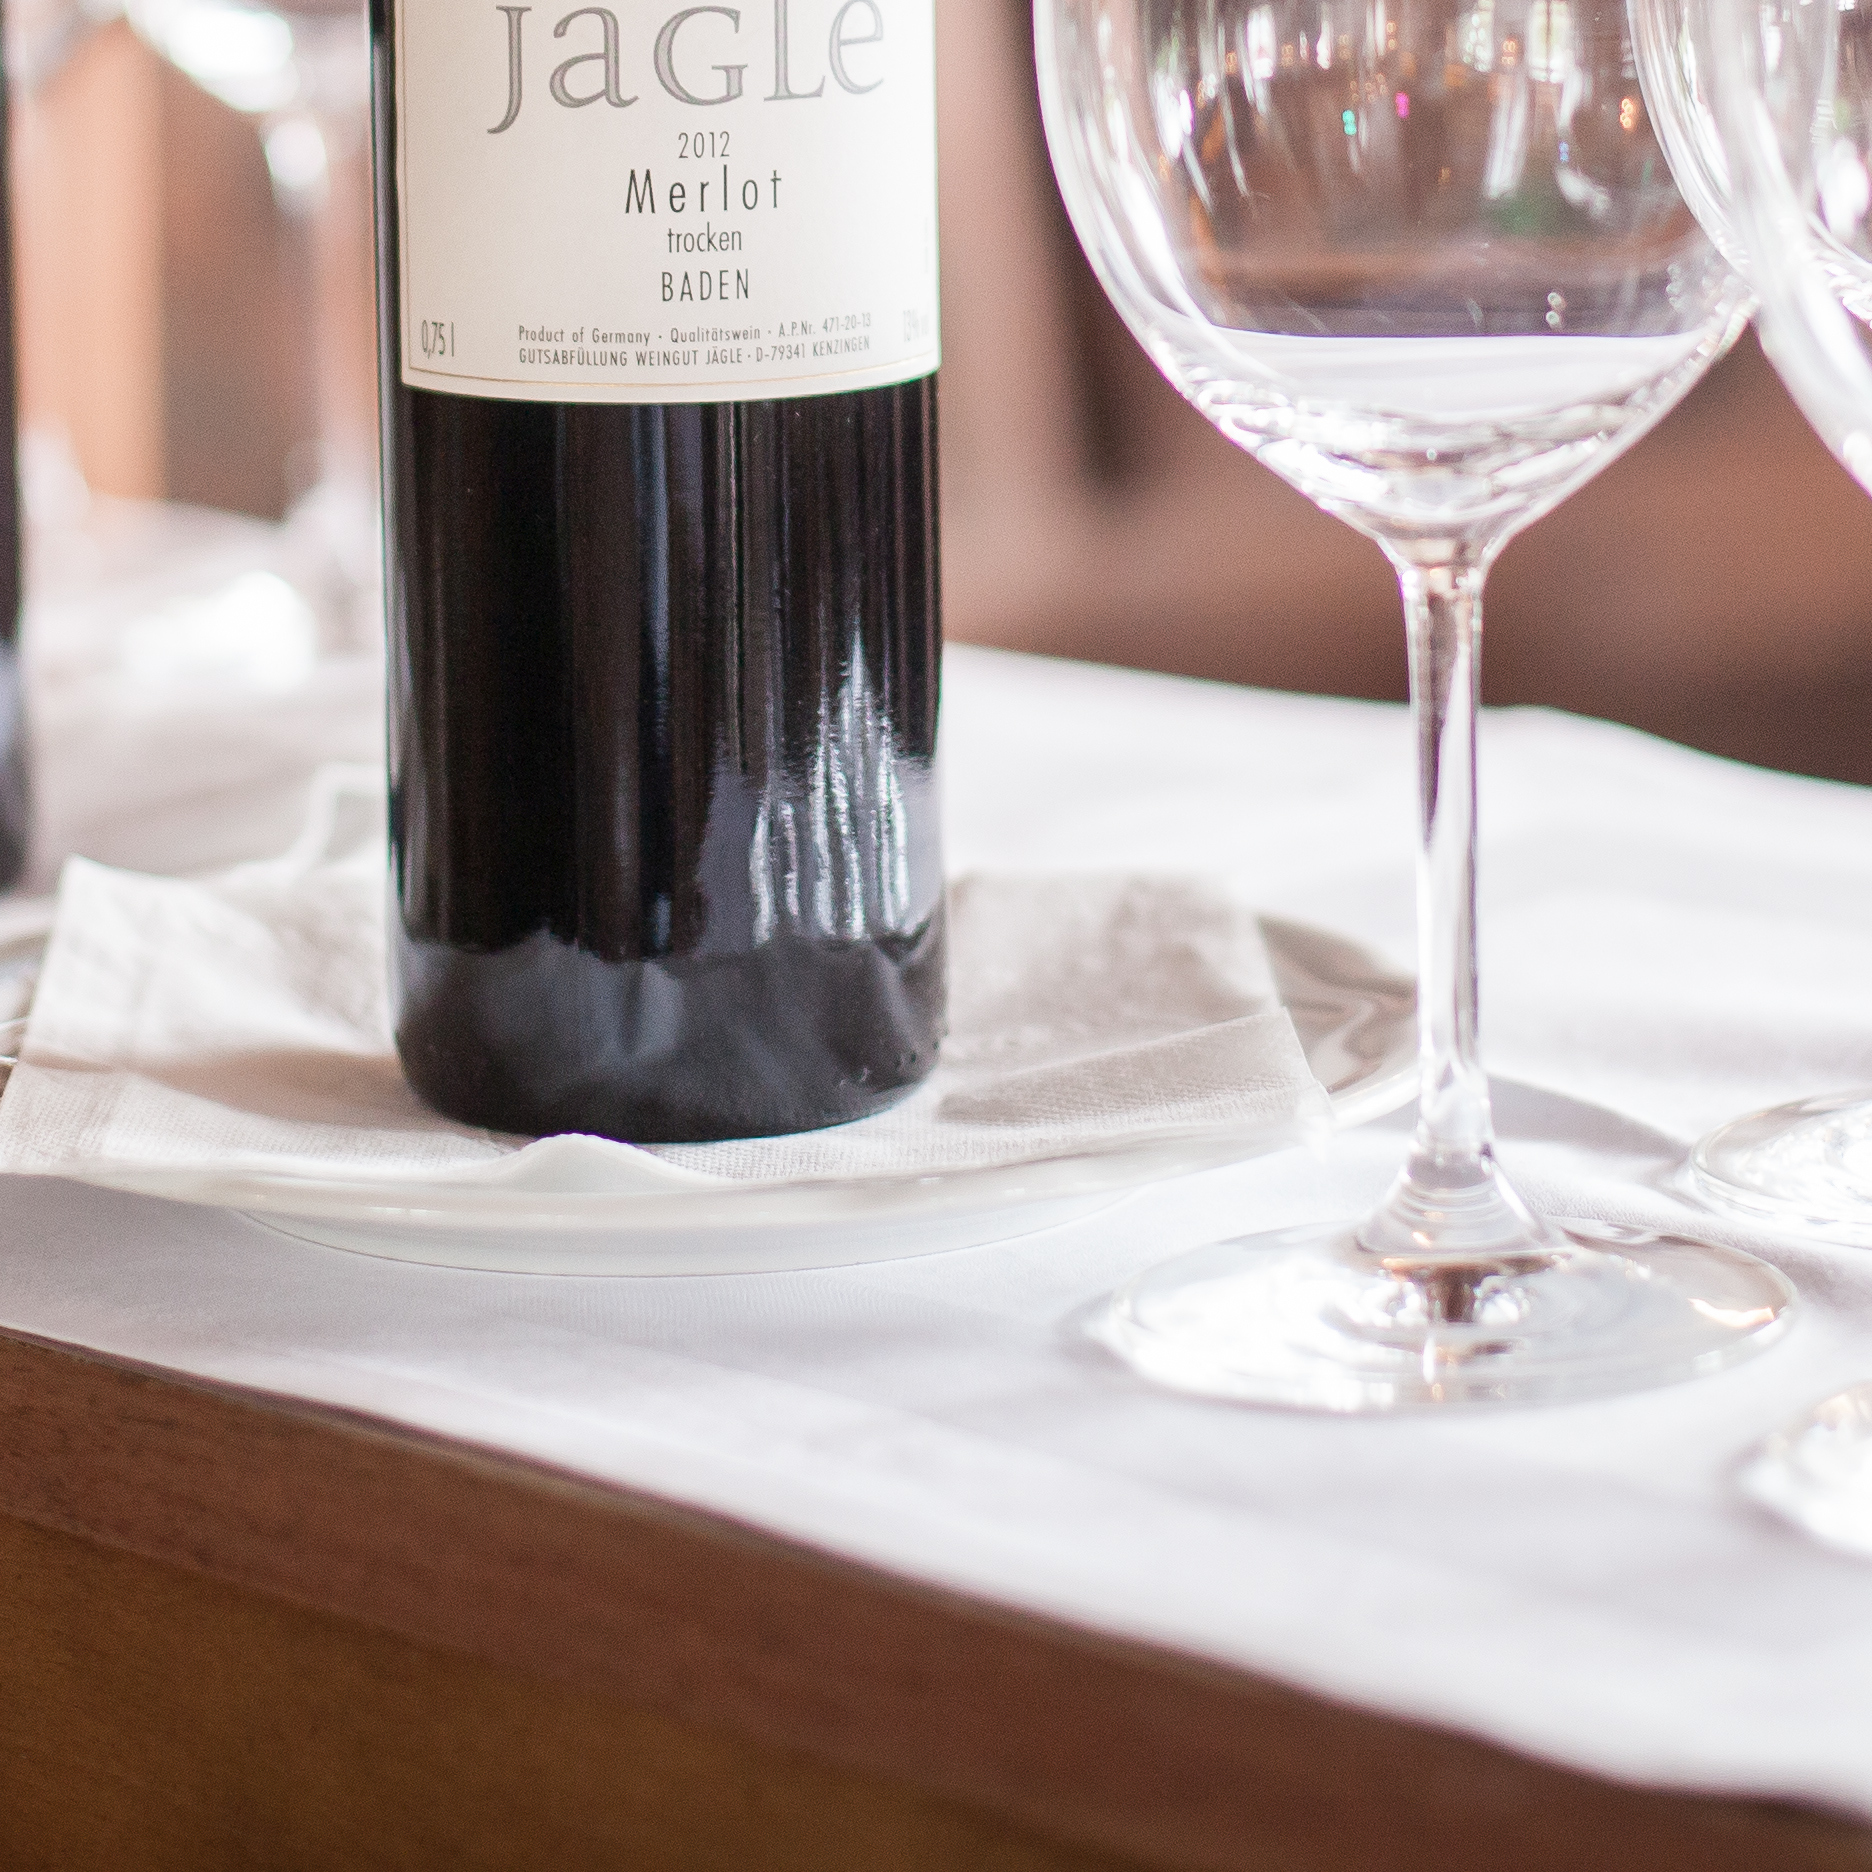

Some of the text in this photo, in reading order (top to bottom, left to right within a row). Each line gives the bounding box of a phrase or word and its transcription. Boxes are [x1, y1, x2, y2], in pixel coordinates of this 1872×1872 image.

[678, 131, 731, 159] 2012
[624, 164, 783, 214] Merlot
[667, 222, 743, 254] trocken
[661, 268, 750, 303] BADEN
[518, 325, 564, 343] Product
[572, 326, 585, 343] of
[591, 328, 651, 346] Germany
[670, 327, 761, 344] Qualitätswein
[518, 335, 871, 367] GUTSABFÜLLUNG WEINGUT JÄGLE D-79341 KENZINGEN
